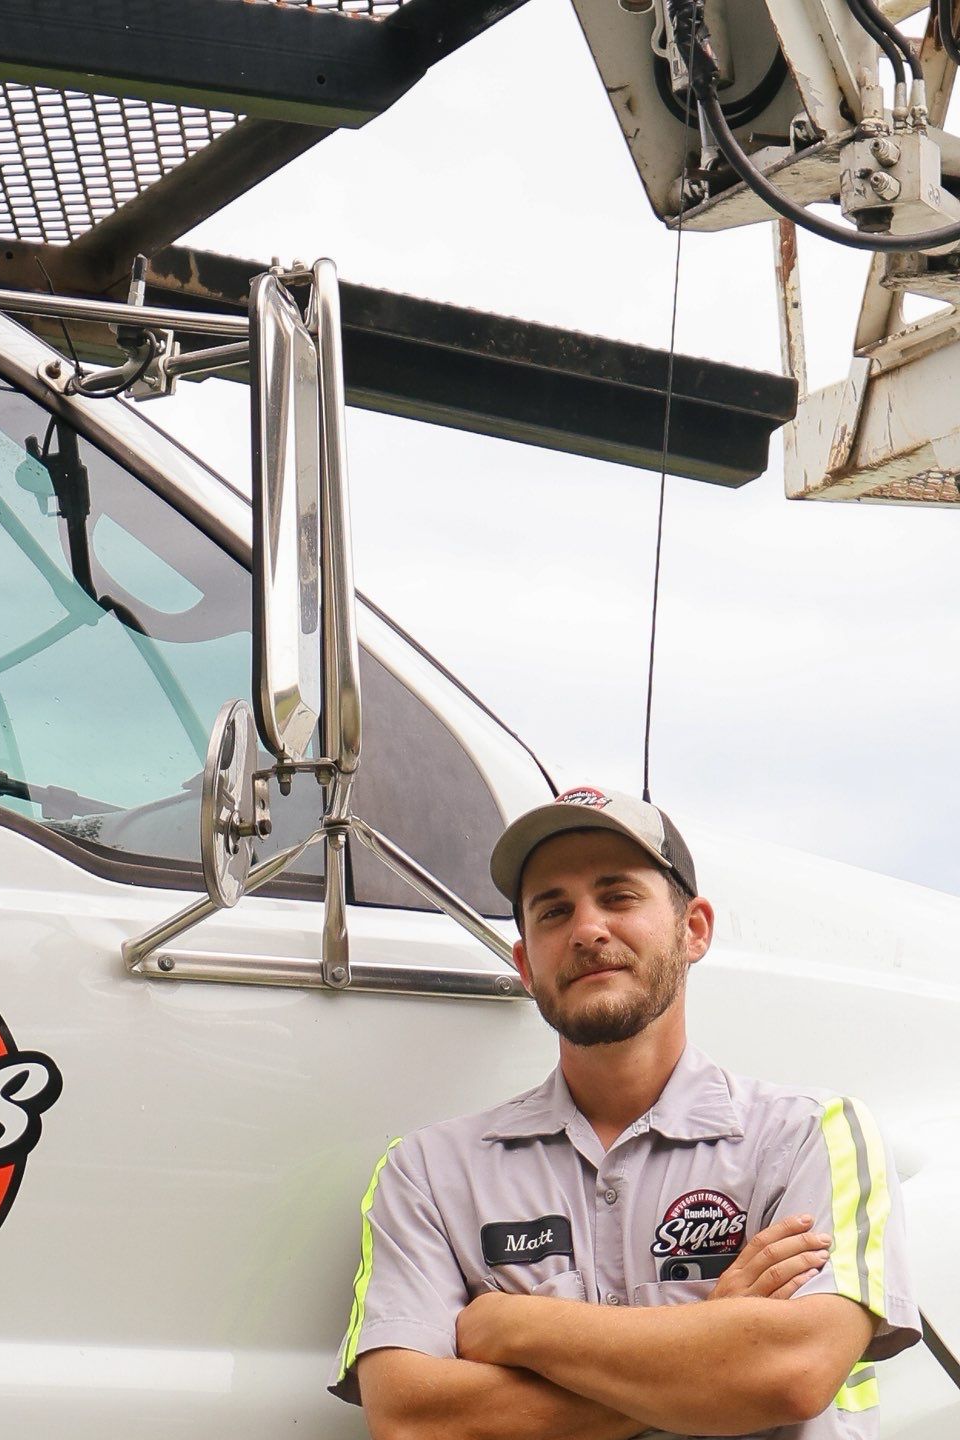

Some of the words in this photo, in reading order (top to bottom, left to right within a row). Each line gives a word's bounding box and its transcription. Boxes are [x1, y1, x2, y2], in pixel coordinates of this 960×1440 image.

[705, 1193, 723, 1204] FROM
[684, 1206, 723, 1220] Randolph
[504, 1229, 554, 1252] Matt
[653, 1213, 747, 1253] Signs
